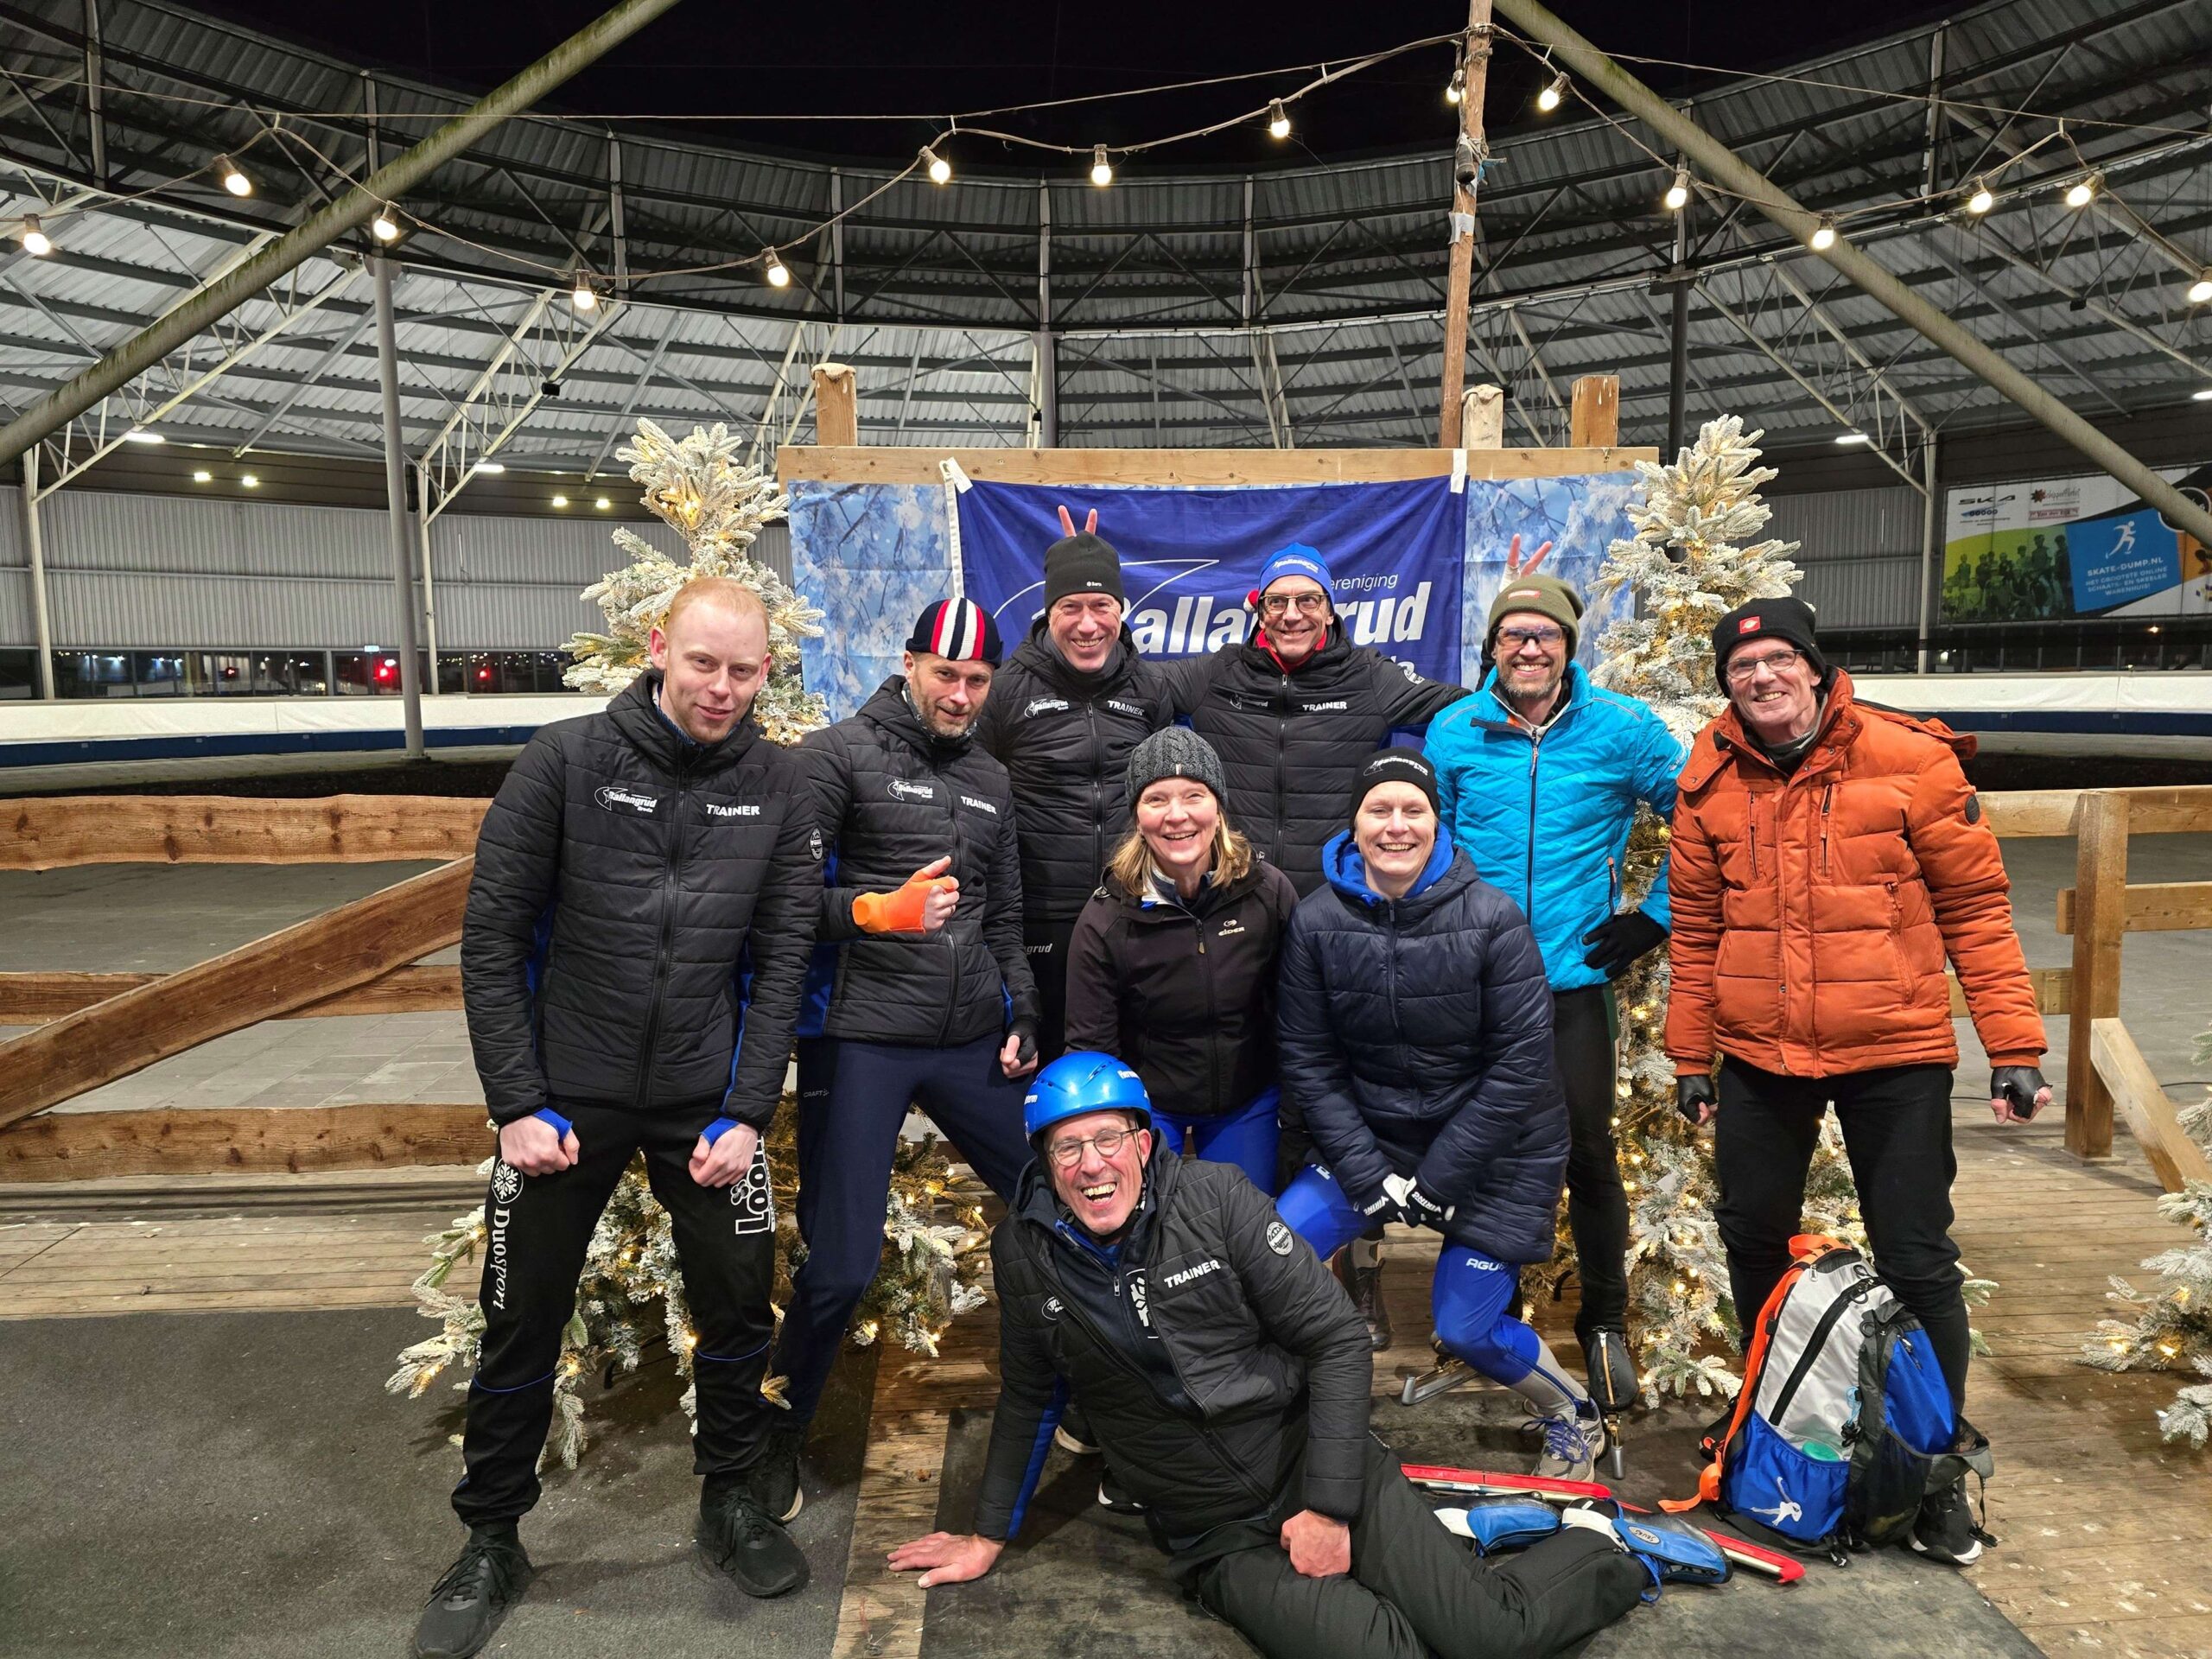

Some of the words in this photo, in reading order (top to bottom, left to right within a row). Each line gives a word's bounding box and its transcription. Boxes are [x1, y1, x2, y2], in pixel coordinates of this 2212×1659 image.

[2087, 556, 2164, 576] SKATE-DUMP.NL
[1331, 573, 1398, 592] ereniging
[1121, 582, 1432, 654] allarud
[1107, 700, 1145, 715] TRAINER
[1302, 701, 1347, 711] TRAINER
[608, 791, 658, 808] Ballangrud
[961, 795, 997, 814] TRAINER
[706, 804, 760, 817] TRAINER
[490, 1206, 510, 1310] Duosport
[1465, 1258, 1499, 1271] AGU
[1164, 1260, 1221, 1288] TRAINER
